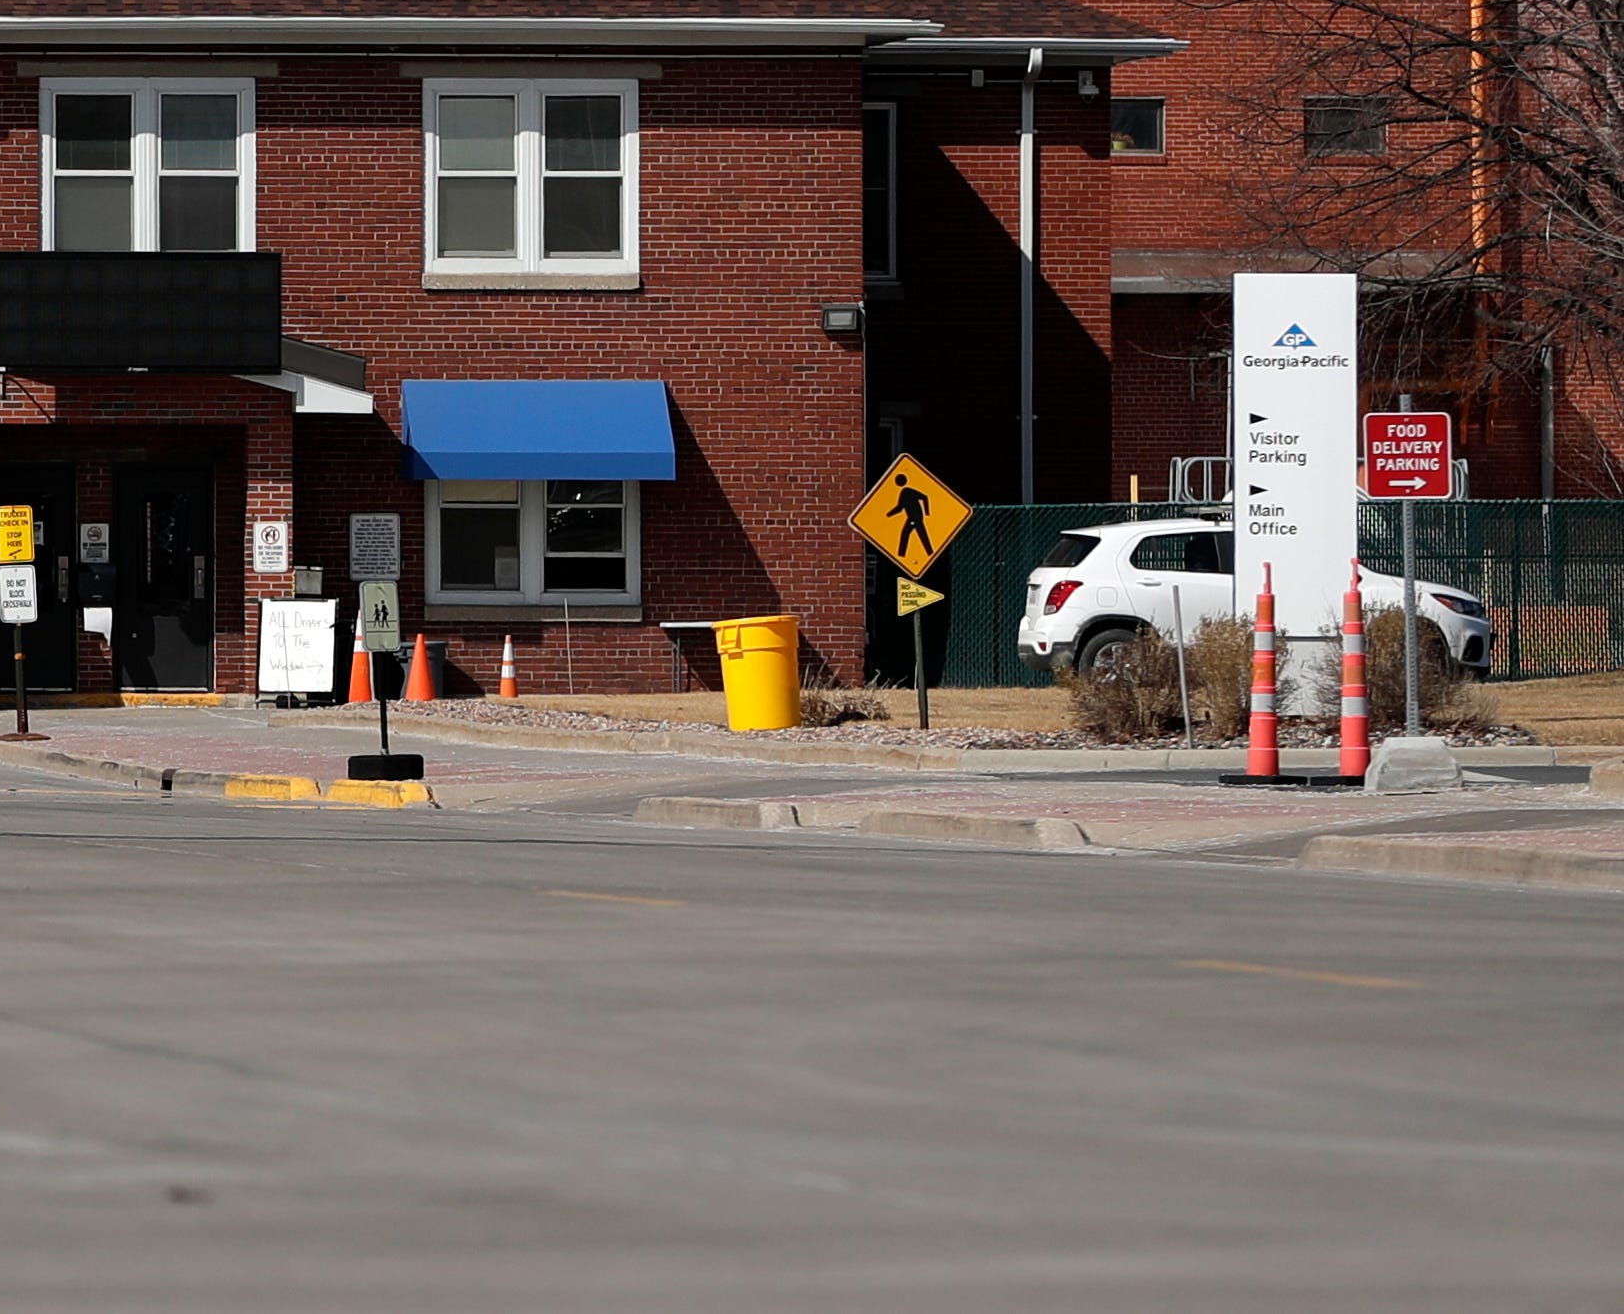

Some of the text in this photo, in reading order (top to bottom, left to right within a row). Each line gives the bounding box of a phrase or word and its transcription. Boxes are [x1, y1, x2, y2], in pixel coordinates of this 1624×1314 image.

[1282, 333, 1307, 346] GP
[1243, 355, 1349, 370] Georgia-Pacific
[1249, 431, 1300, 445] Visitor
[1387, 424, 1428, 438] FOOD
[1372, 441, 1444, 455] DELIVERY
[1249, 449, 1307, 466] Parking
[1376, 457, 1441, 472] PARKING
[1249, 504, 1285, 517] Main
[6, 531, 22, 539] STOP
[1249, 522, 1298, 536] Office
